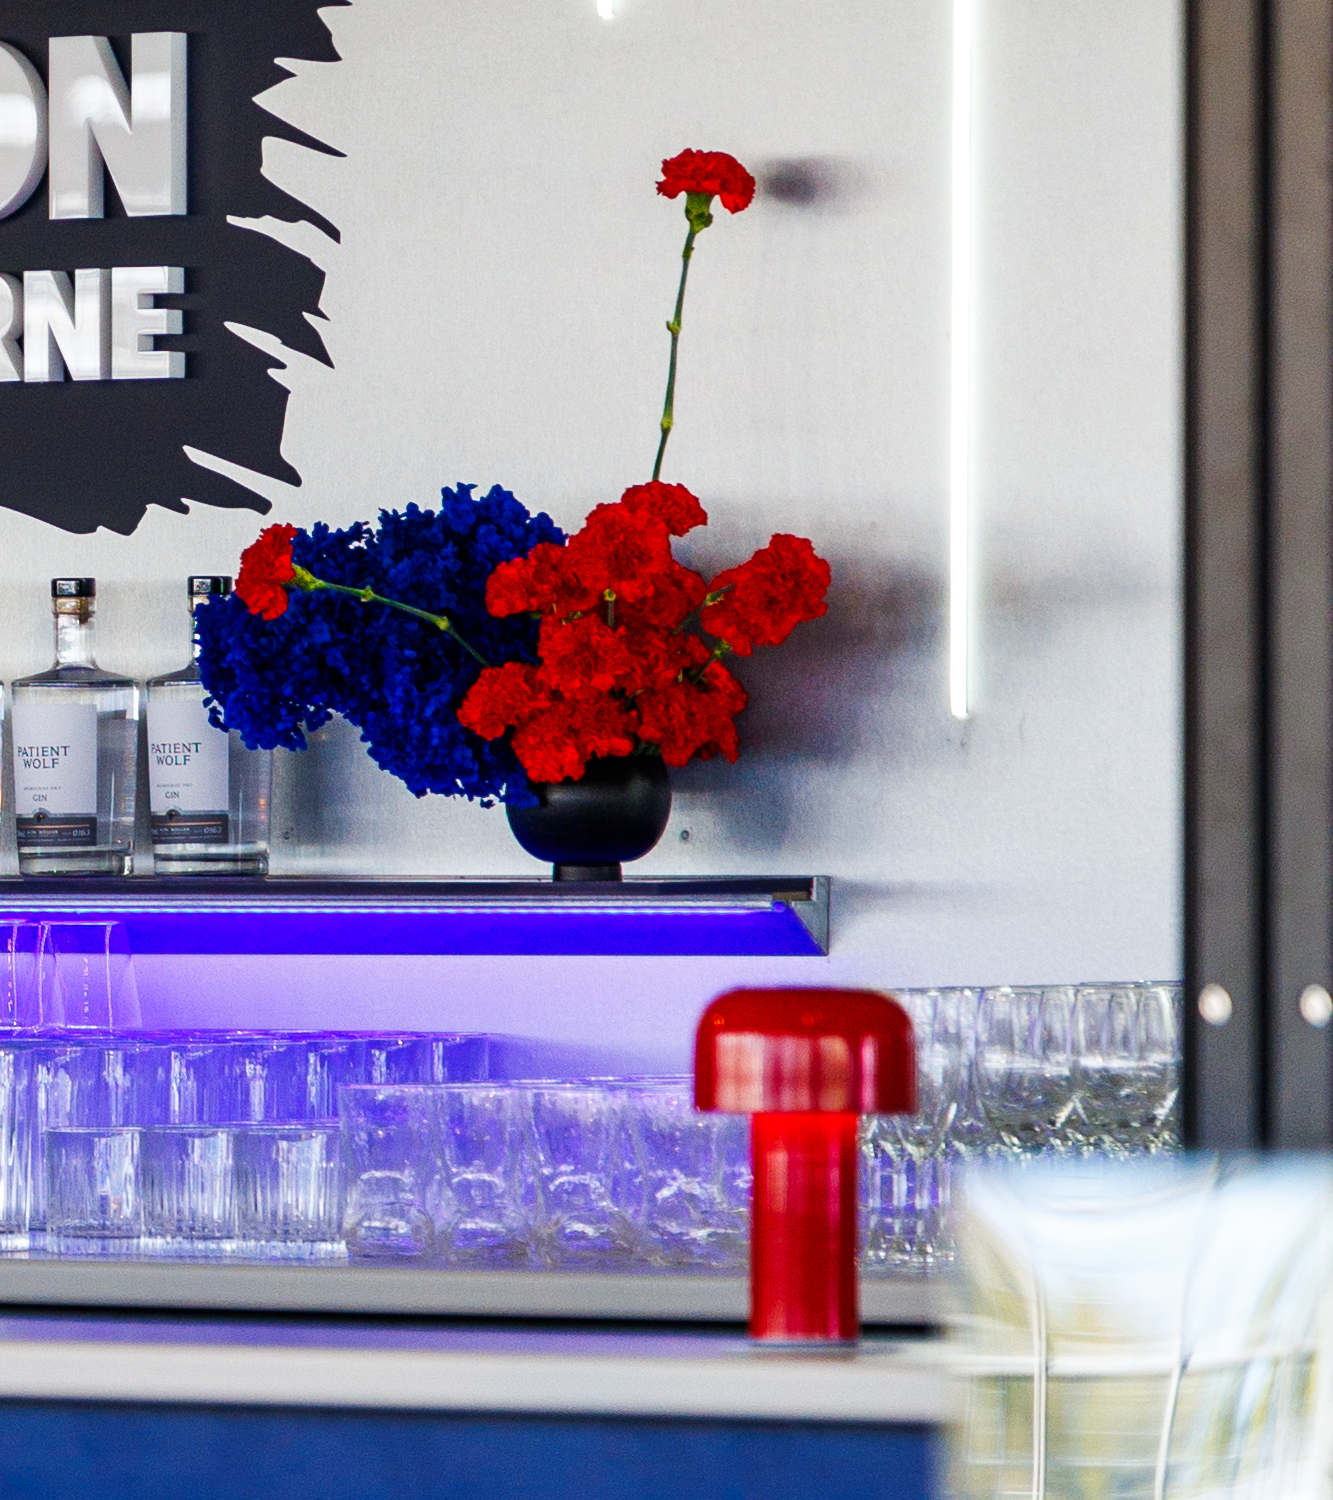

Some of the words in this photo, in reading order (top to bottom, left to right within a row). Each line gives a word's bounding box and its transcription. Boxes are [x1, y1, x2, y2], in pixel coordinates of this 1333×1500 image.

[17, 745, 71, 757] PATIENT
[151, 742, 202, 754] PATIENT
[23, 758, 60, 769] WOLF
[156, 755, 191, 766] WOLF
[32, 794, 48, 802] GIN
[165, 791, 180, 799] GIN
